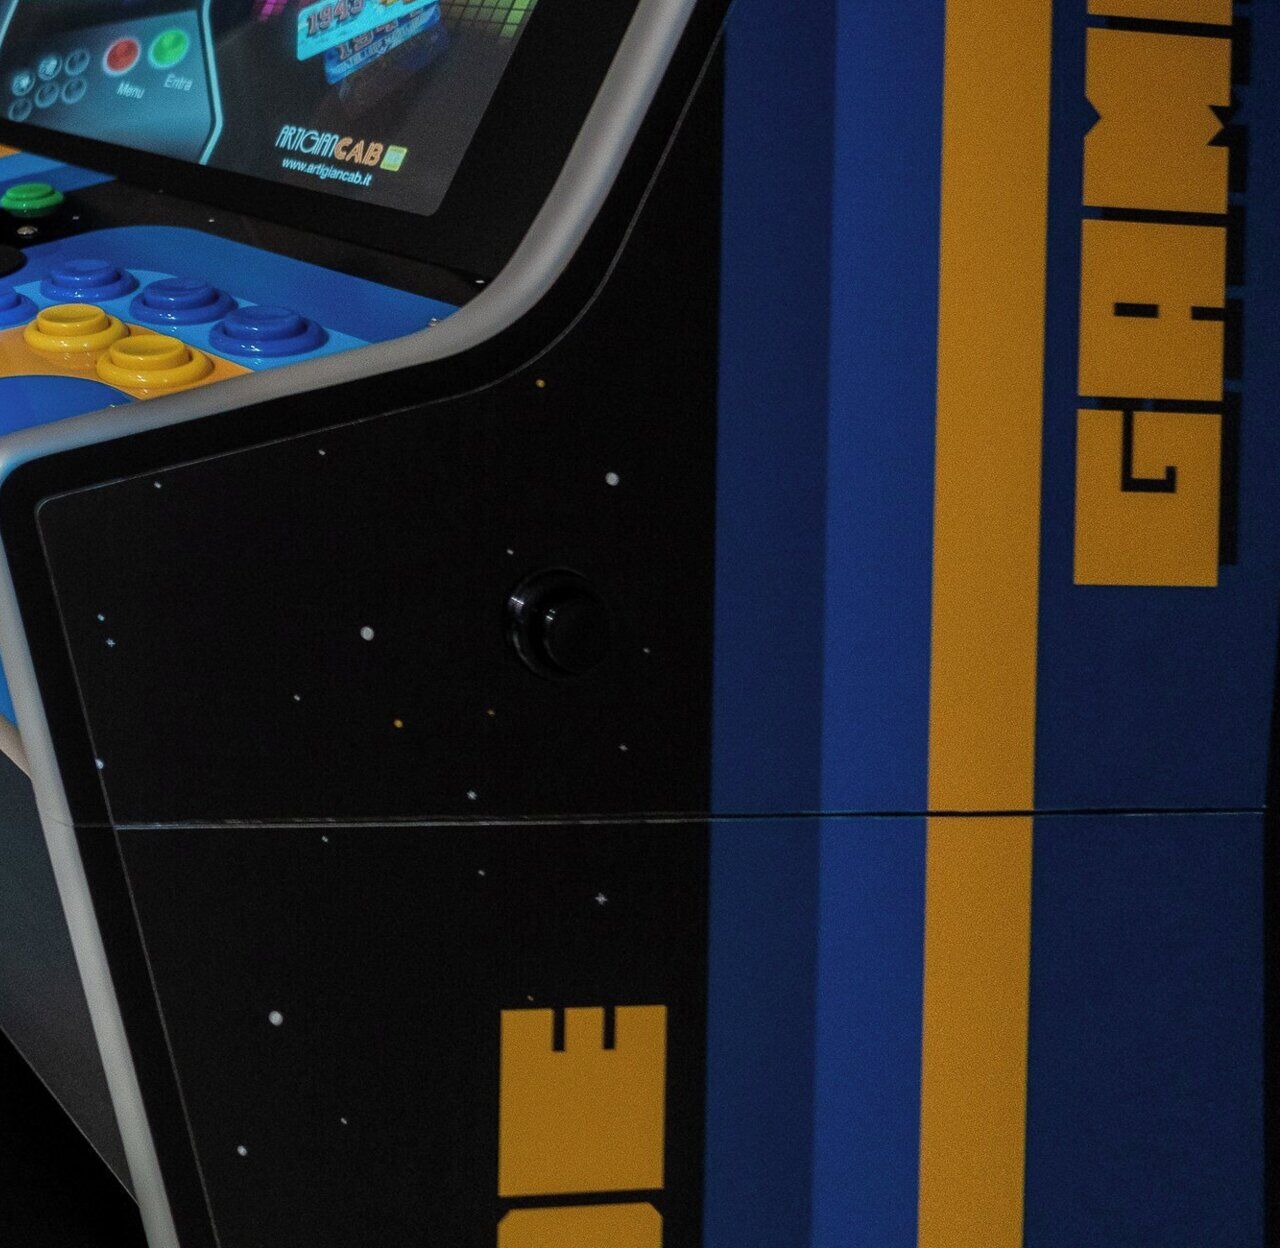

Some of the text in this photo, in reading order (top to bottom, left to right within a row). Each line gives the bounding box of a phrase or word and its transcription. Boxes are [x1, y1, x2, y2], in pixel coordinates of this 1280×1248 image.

[116, 81, 146, 99] Menu
[162, 72, 193, 91] Entra
[274, 124, 385, 167] ARTIGIANCAB
[281, 157, 374, 187] www.artigiancab.it
